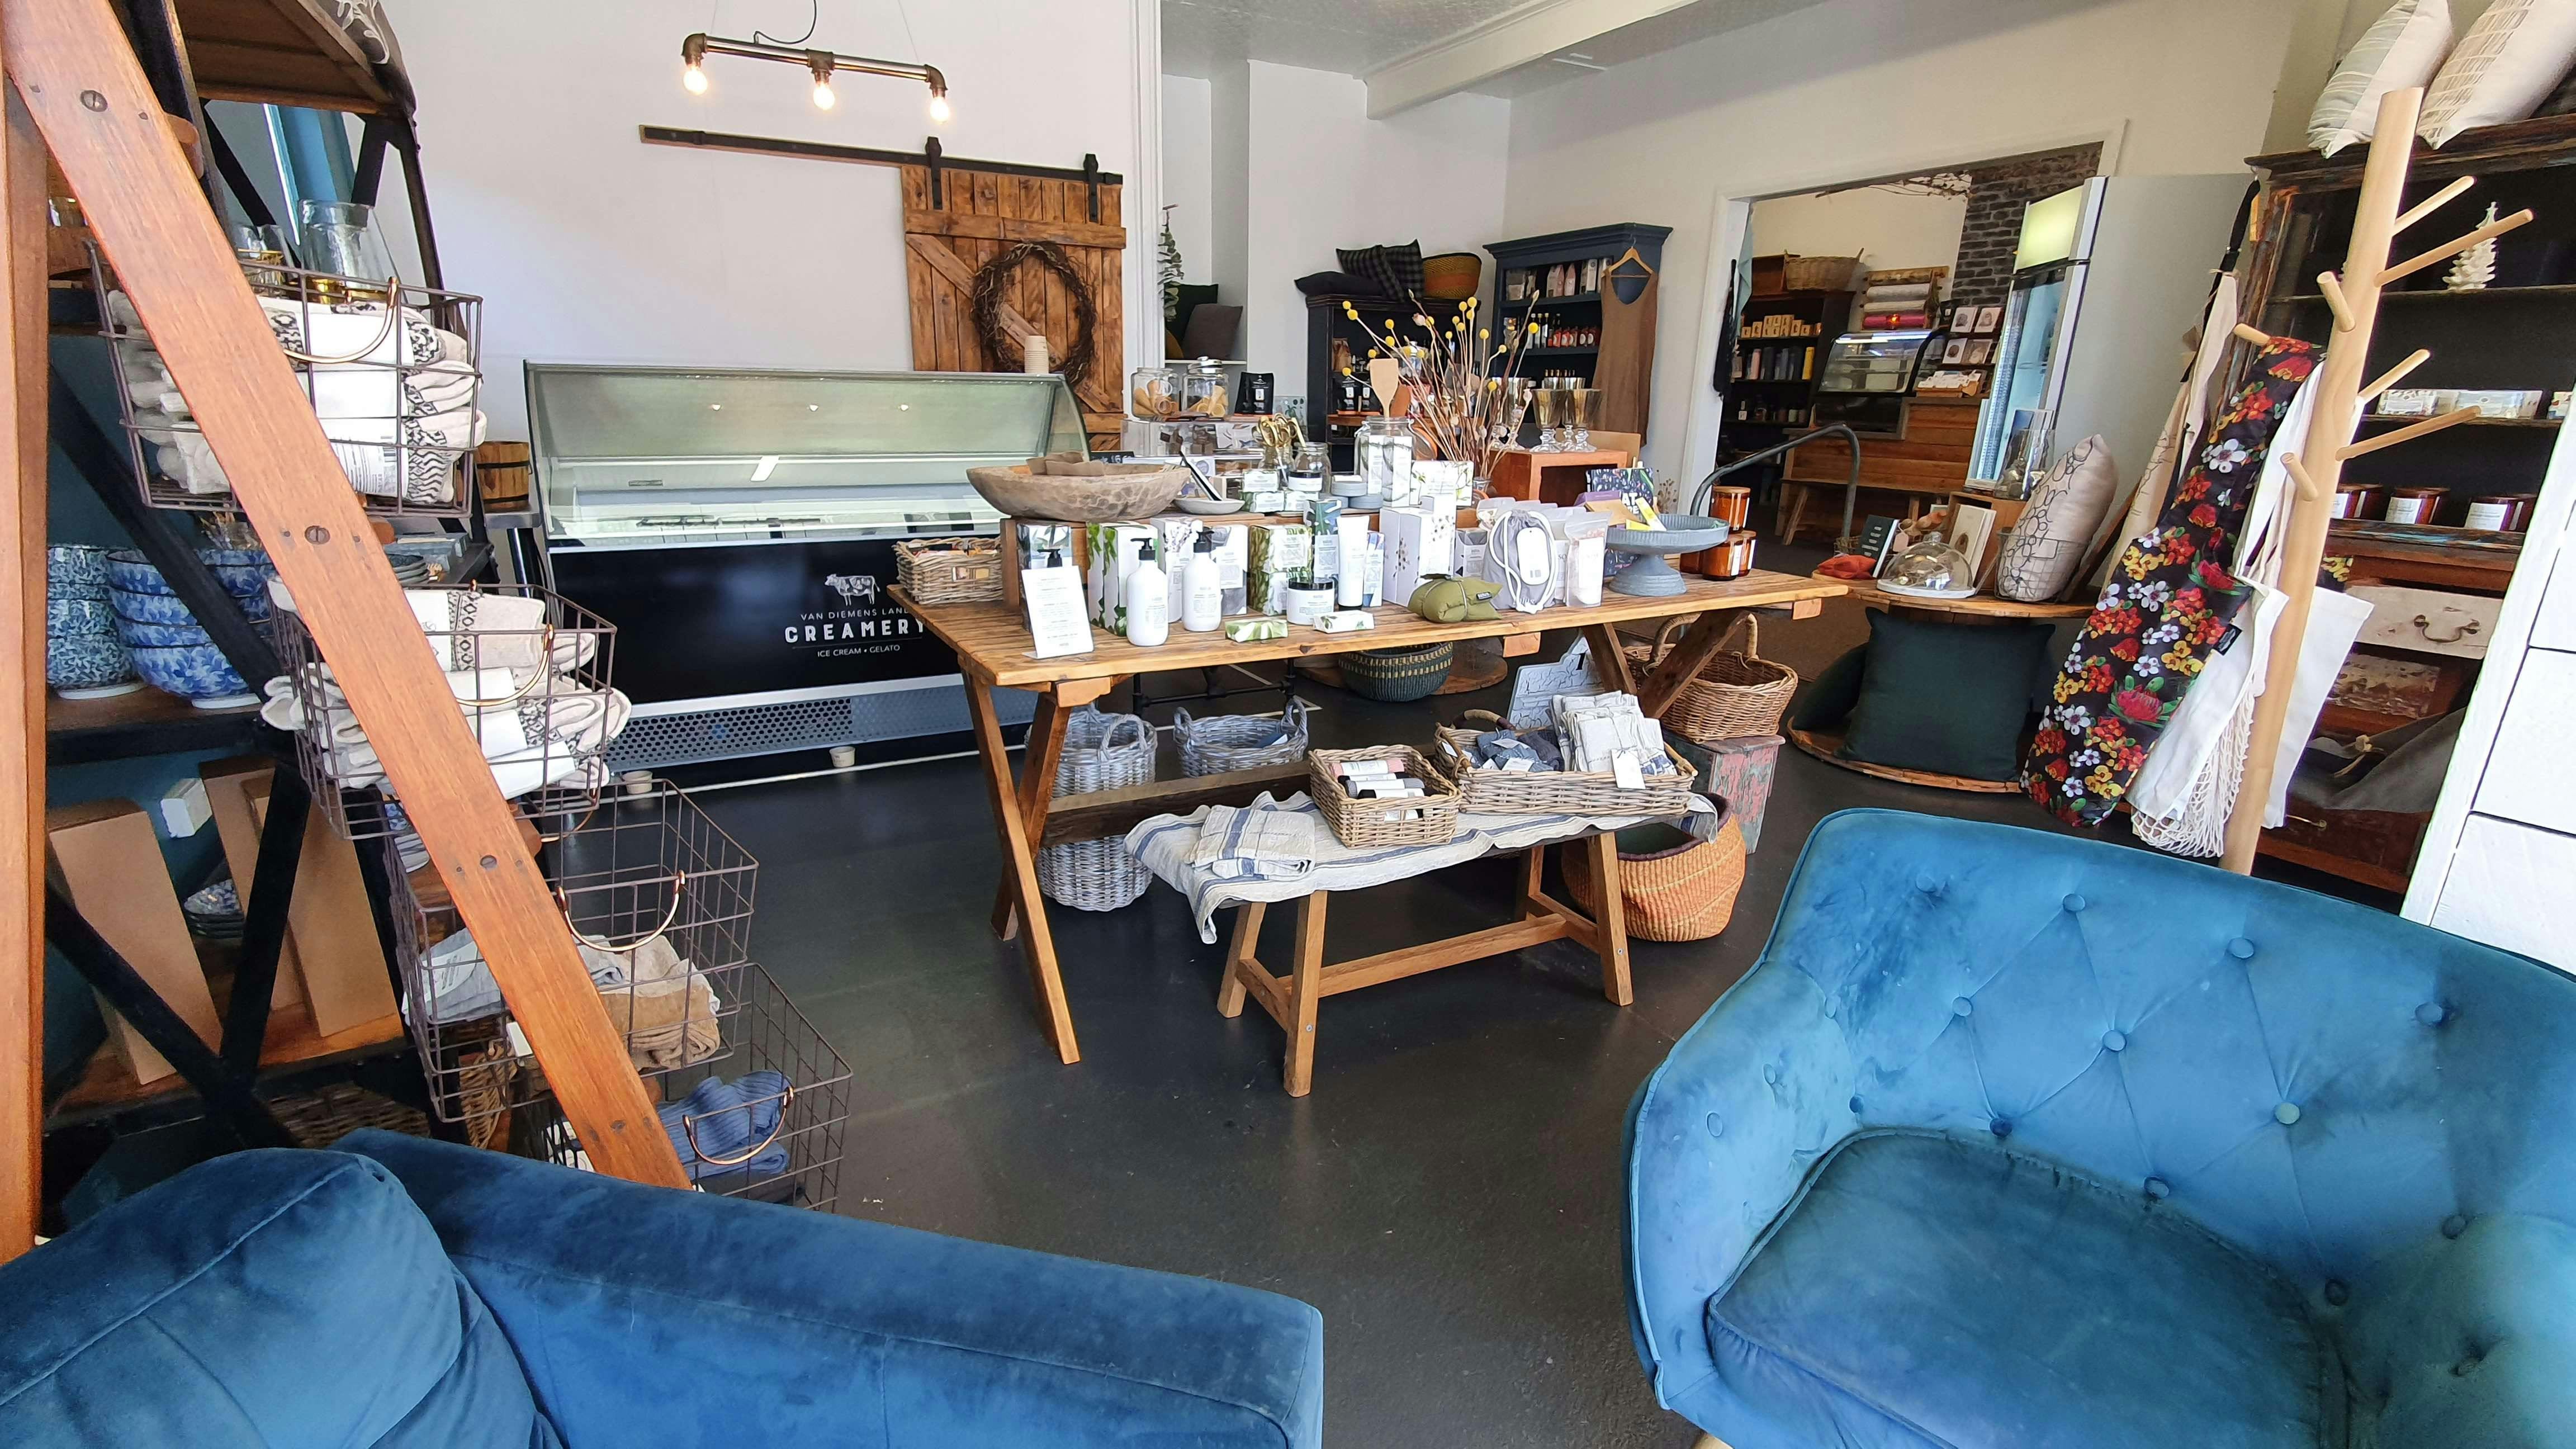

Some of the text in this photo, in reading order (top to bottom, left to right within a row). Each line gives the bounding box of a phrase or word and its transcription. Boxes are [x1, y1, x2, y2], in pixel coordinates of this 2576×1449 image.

[801, 612, 823, 621] VAN
[828, 608, 877, 619] DIEMENS
[784, 619, 923, 643] CREAMERY
[833, 648, 861, 656] CREAM
[869, 645, 900, 653] GELATO
